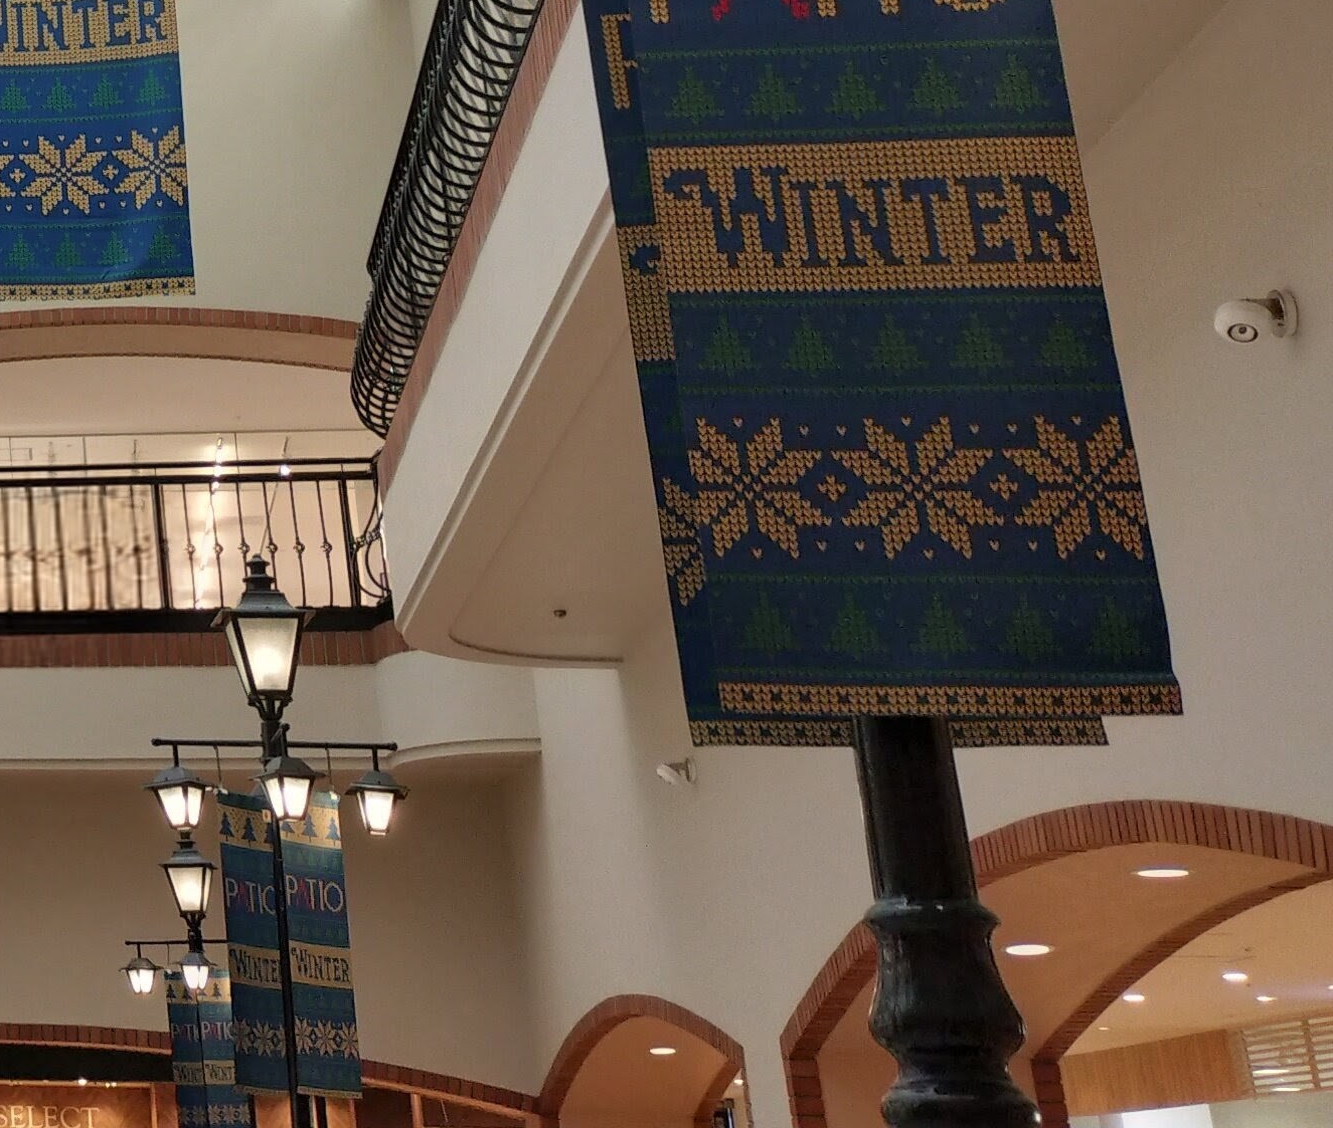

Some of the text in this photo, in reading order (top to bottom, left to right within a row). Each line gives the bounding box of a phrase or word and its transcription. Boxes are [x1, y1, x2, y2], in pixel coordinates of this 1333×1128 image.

[663, 164, 1081, 271] WINTER
[285, 874, 344, 912] PATIO
[290, 946, 351, 983] WINTER
